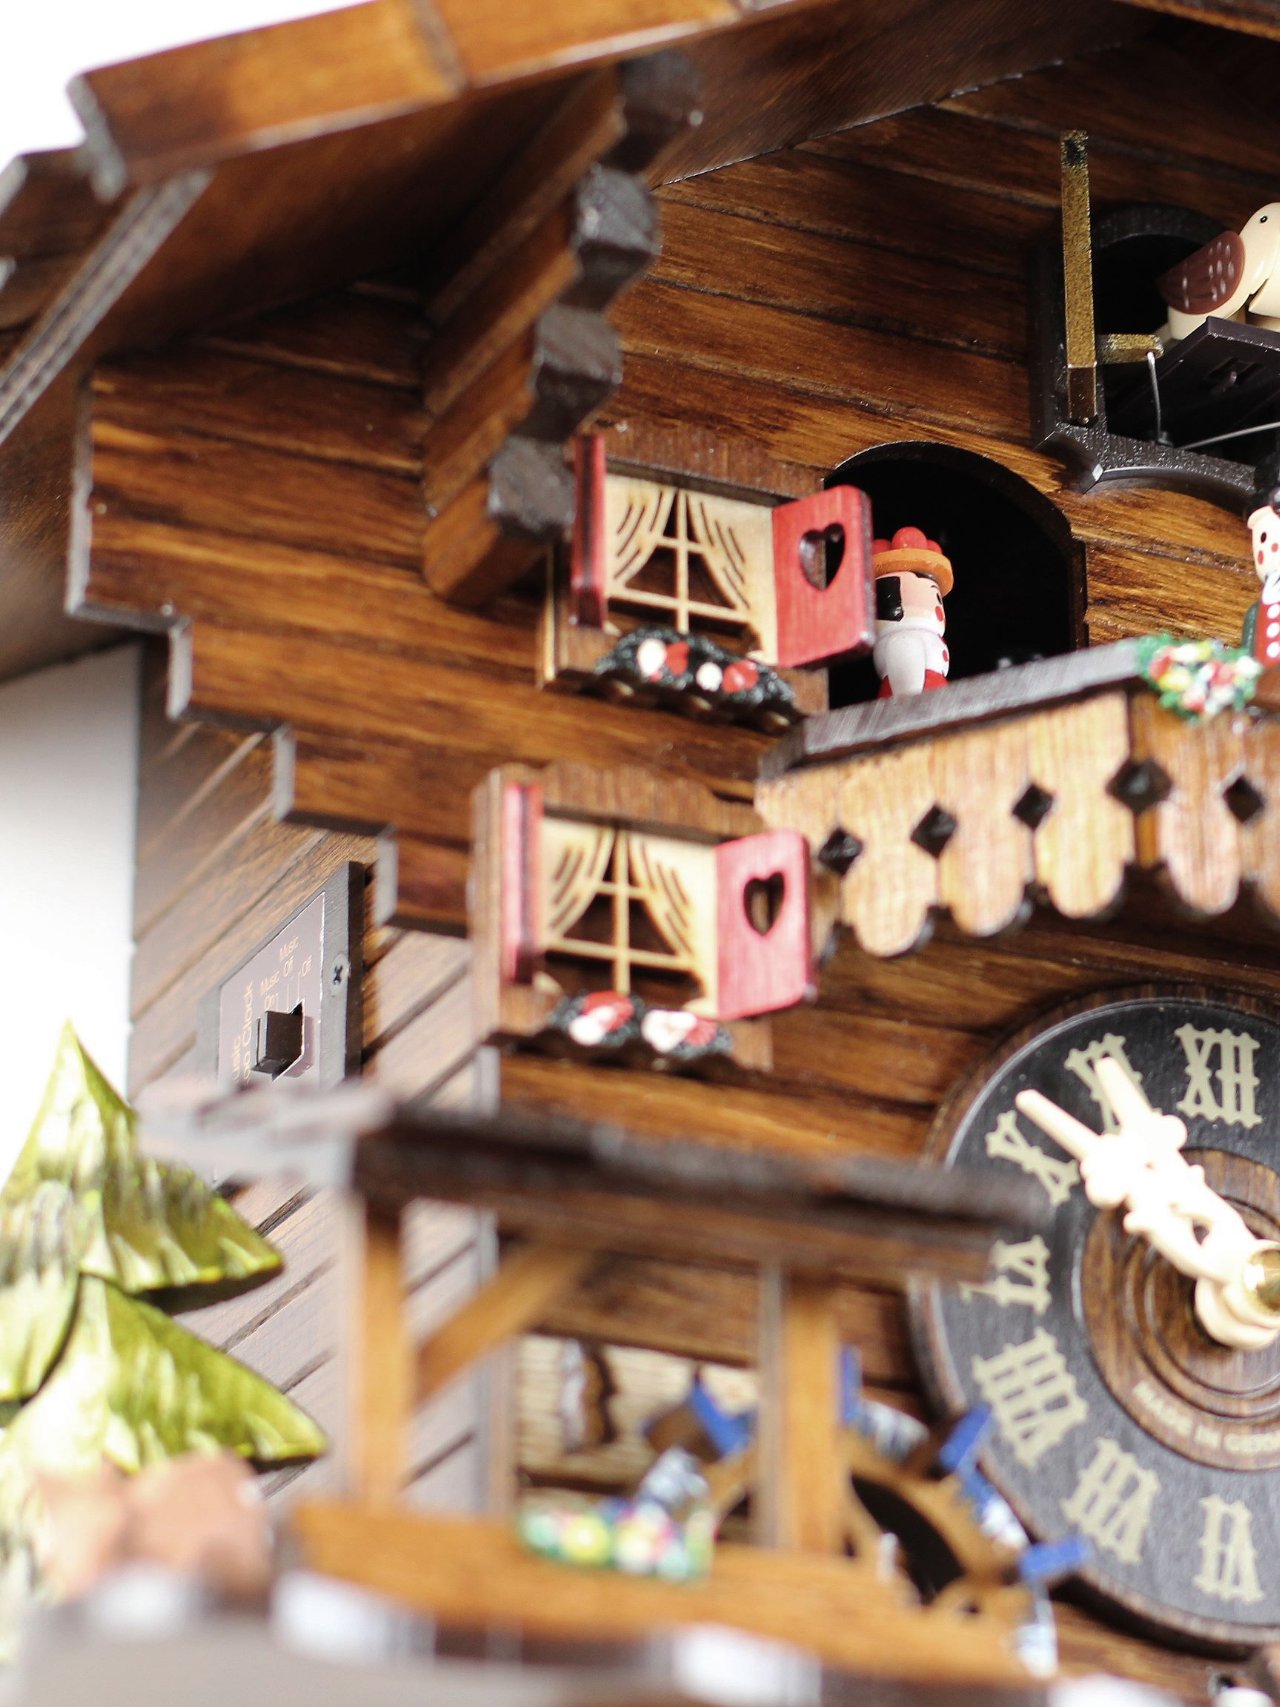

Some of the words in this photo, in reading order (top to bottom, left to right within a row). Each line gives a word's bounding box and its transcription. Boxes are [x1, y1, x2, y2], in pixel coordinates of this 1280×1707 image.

[1175, 1022, 1262, 1128] XII
[985, 1109, 1080, 1204] X
[972, 1327, 1090, 1471] VIII
[1132, 1380, 1194, 1437] MADE
[1194, 1424, 1223, 1449] IN
[1060, 1437, 1161, 1564] VII
[1193, 1494, 1265, 1604] VI
